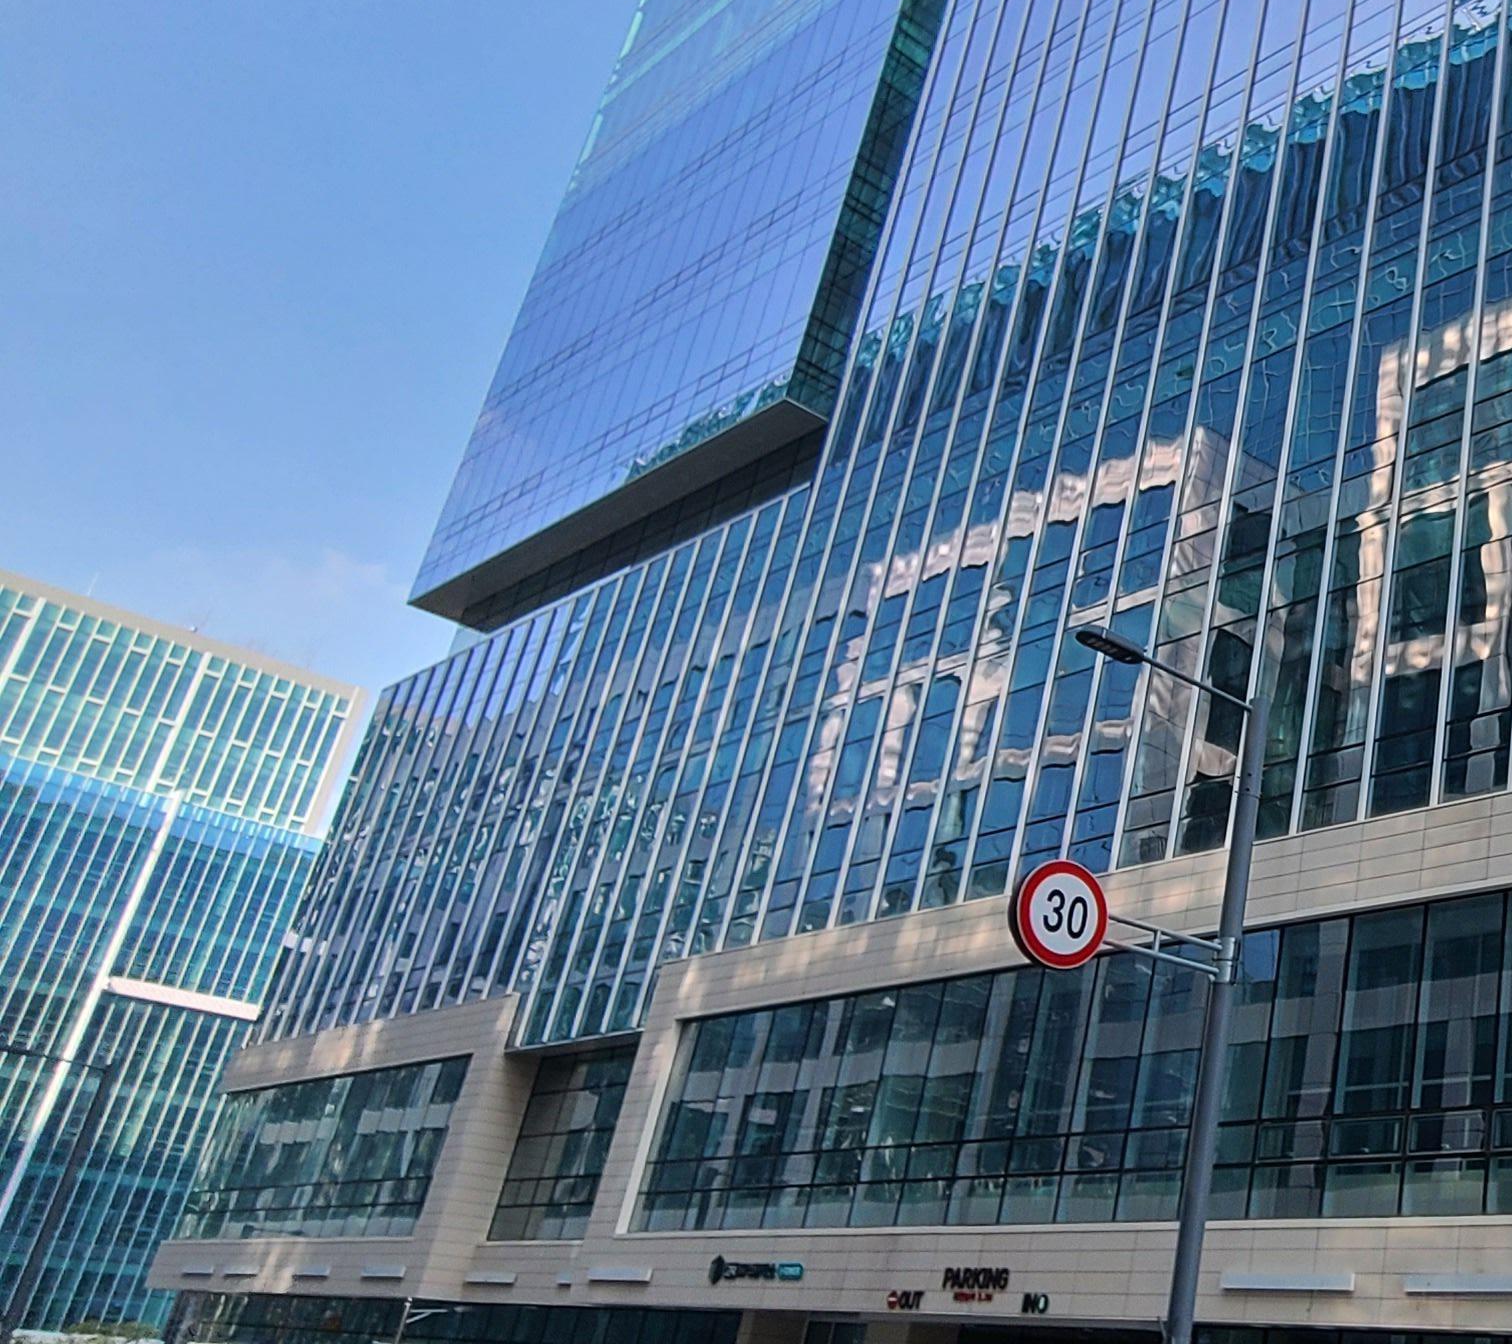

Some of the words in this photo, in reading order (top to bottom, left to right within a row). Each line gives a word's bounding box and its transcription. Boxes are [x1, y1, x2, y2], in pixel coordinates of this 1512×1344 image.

[1043, 889, 1088, 939] 30
[942, 1268, 1010, 1290] PARKING
[899, 1291, 925, 1310] OUT
